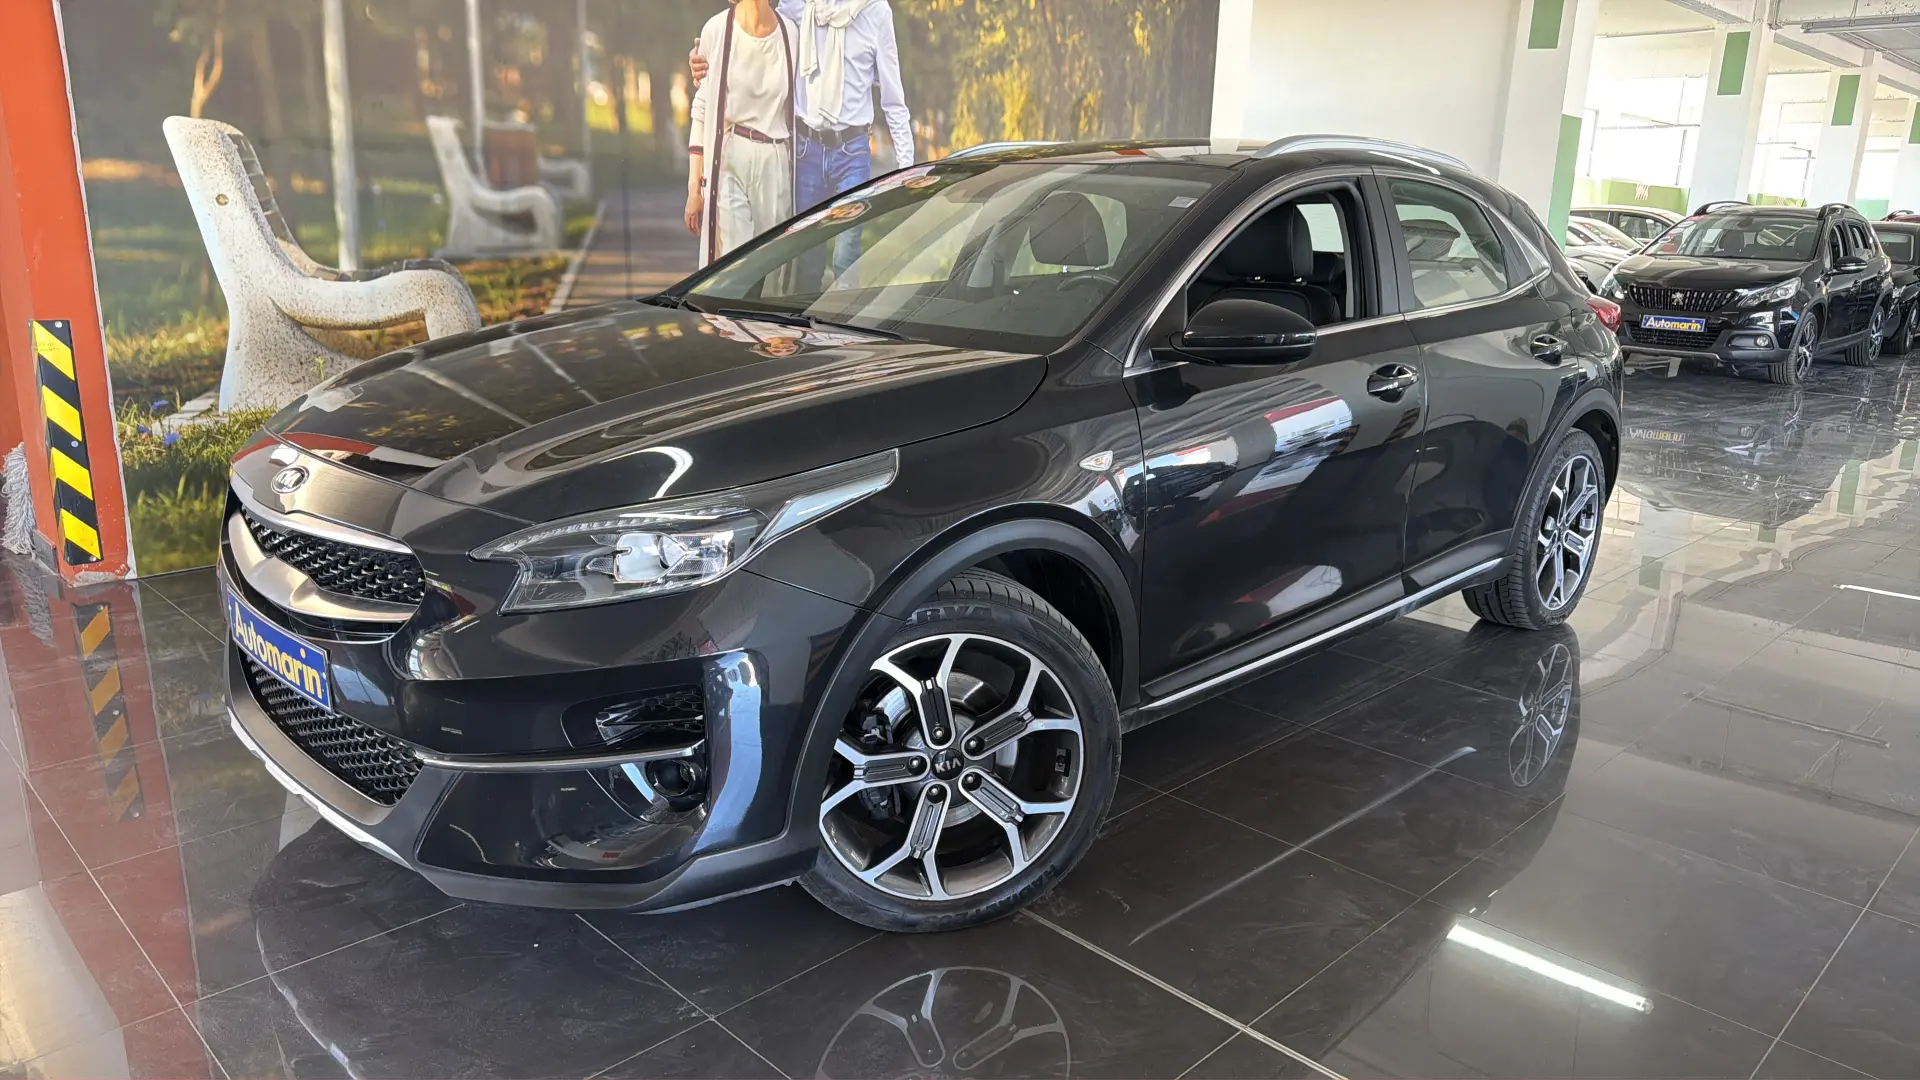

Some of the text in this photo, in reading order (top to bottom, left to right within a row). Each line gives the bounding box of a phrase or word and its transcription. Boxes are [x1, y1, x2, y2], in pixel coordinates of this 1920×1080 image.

[1646, 316, 1701, 330] Automarin
[235, 601, 322, 699] Automarin
[935, 757, 961, 773] KIA
